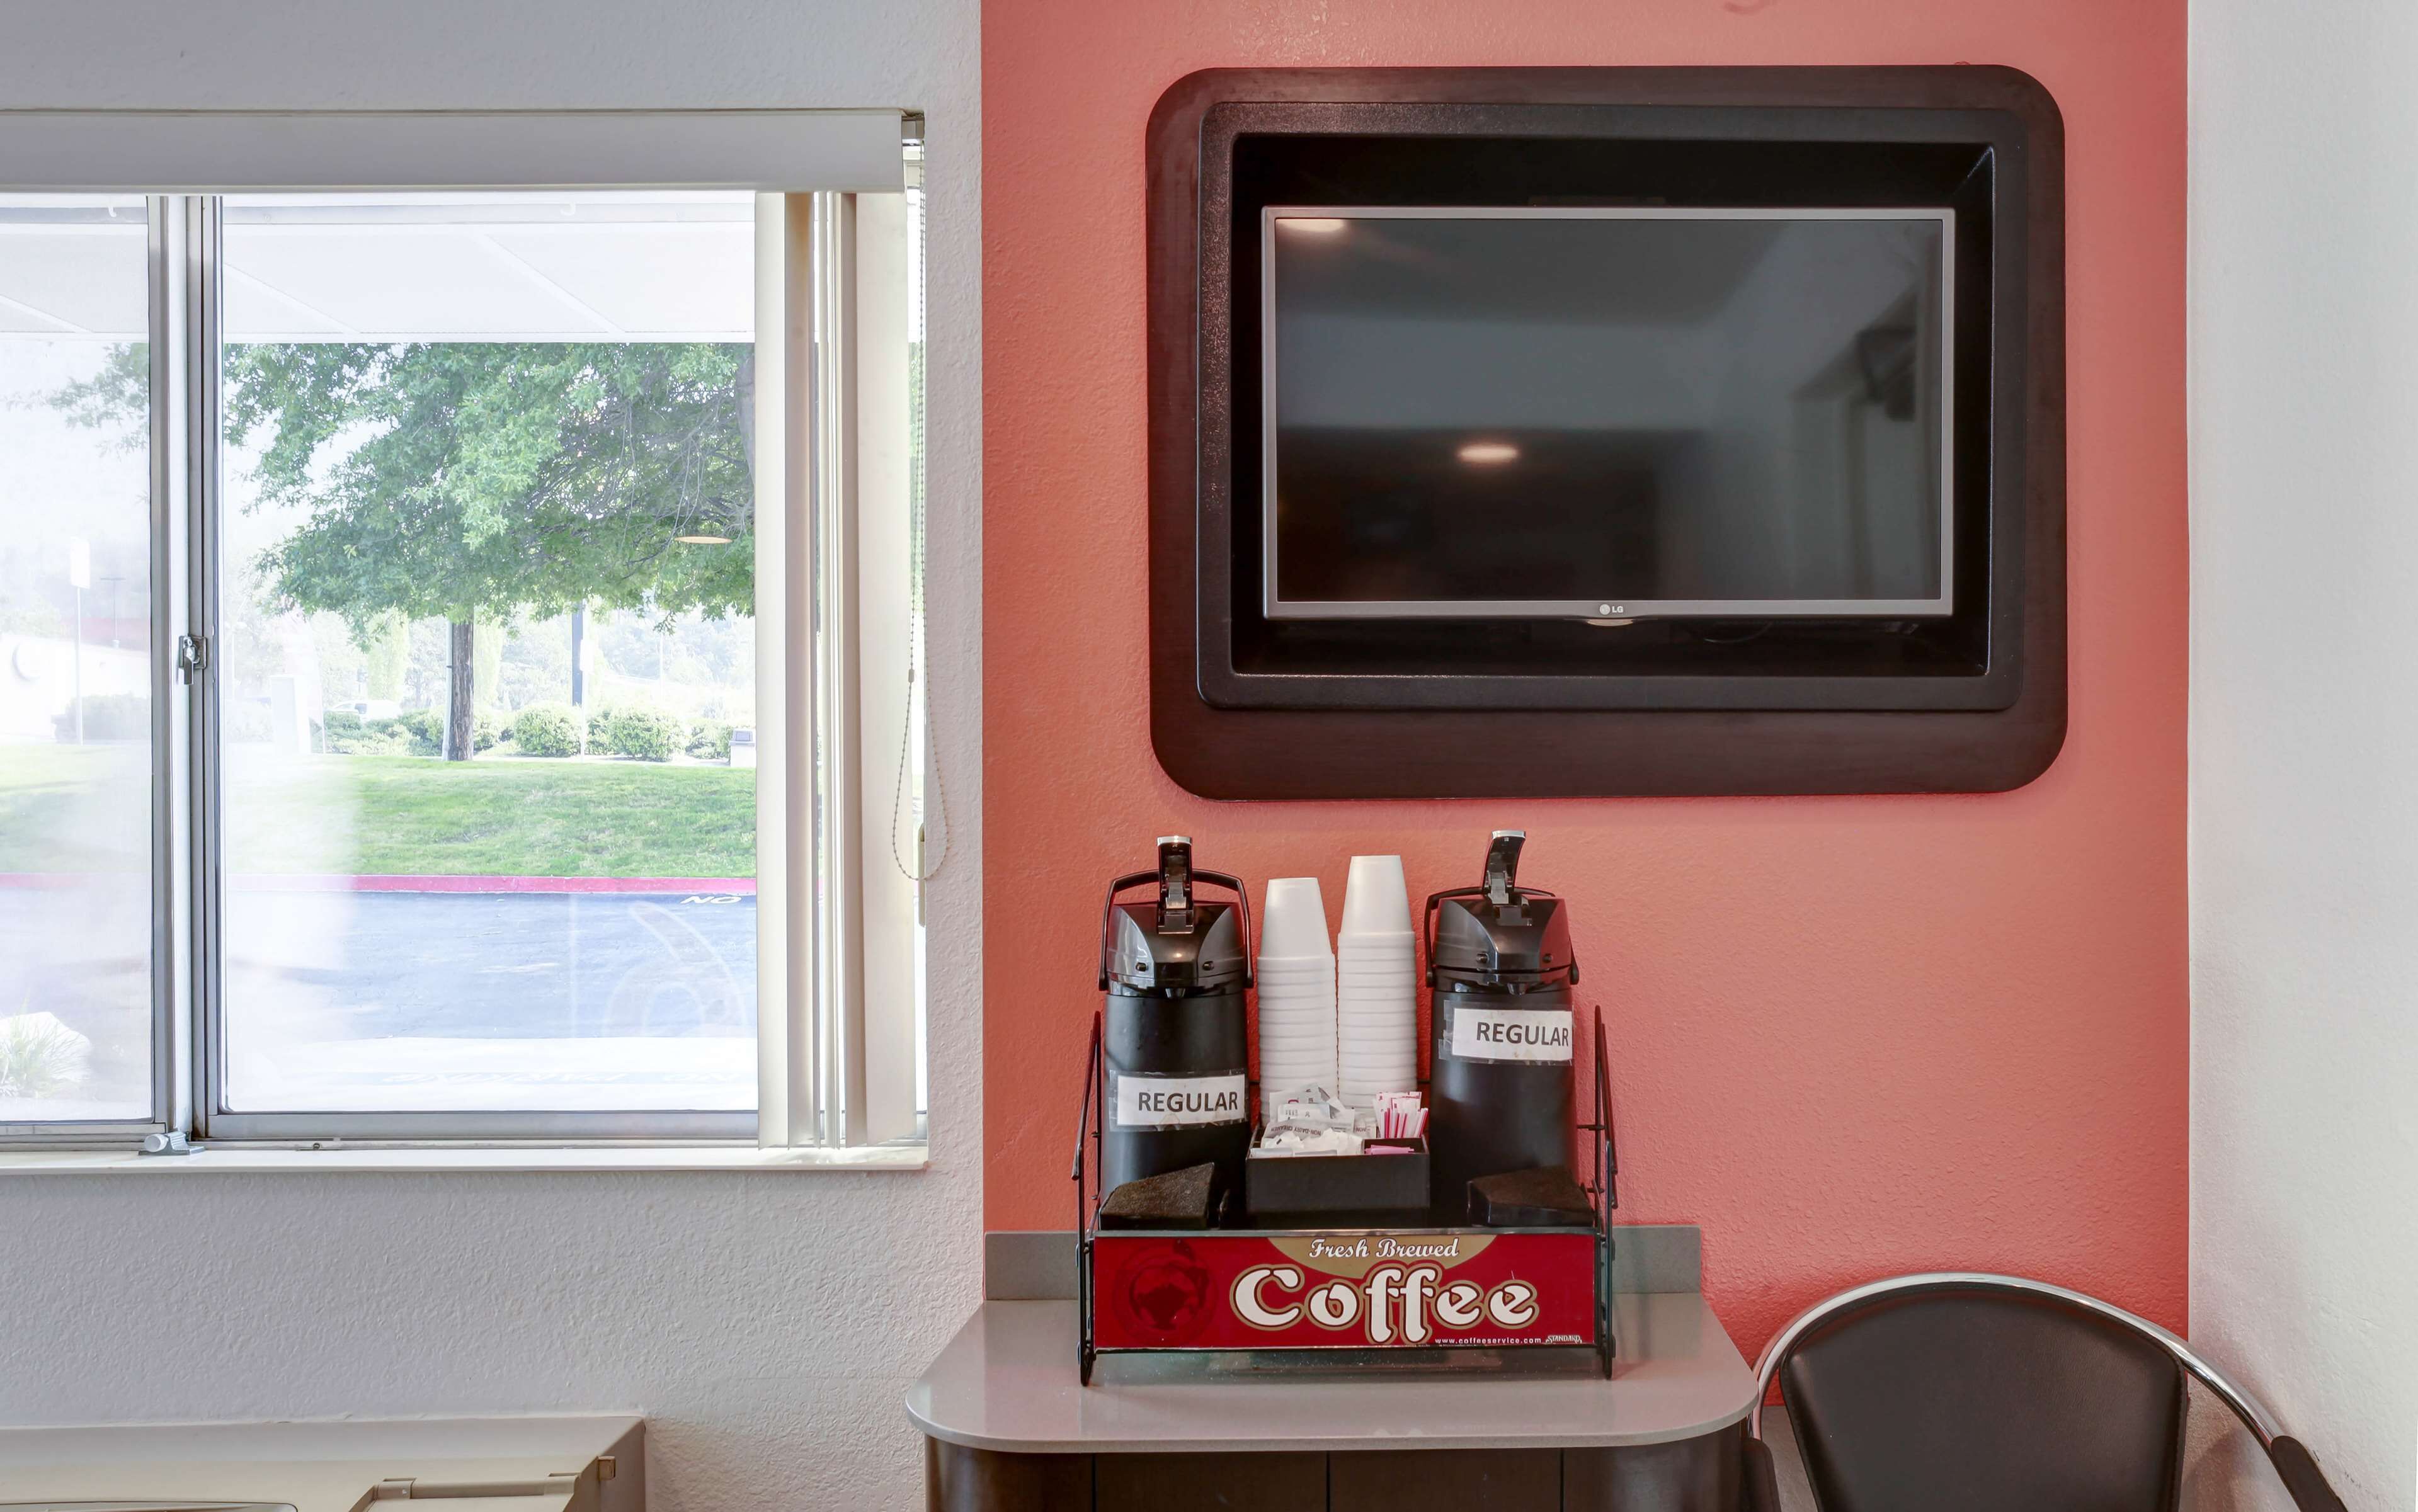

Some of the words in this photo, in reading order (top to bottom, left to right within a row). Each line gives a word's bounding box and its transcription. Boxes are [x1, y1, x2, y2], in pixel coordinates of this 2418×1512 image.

[680, 895, 742, 904] NO
[1476, 1021, 1569, 1047] REGULAR
[1138, 1091, 1238, 1113] REGULAR
[1309, 1237, 1369, 1258] Fresh
[1376, 1237, 1459, 1258] Brewed
[1231, 1263, 1538, 1344] Coffee
